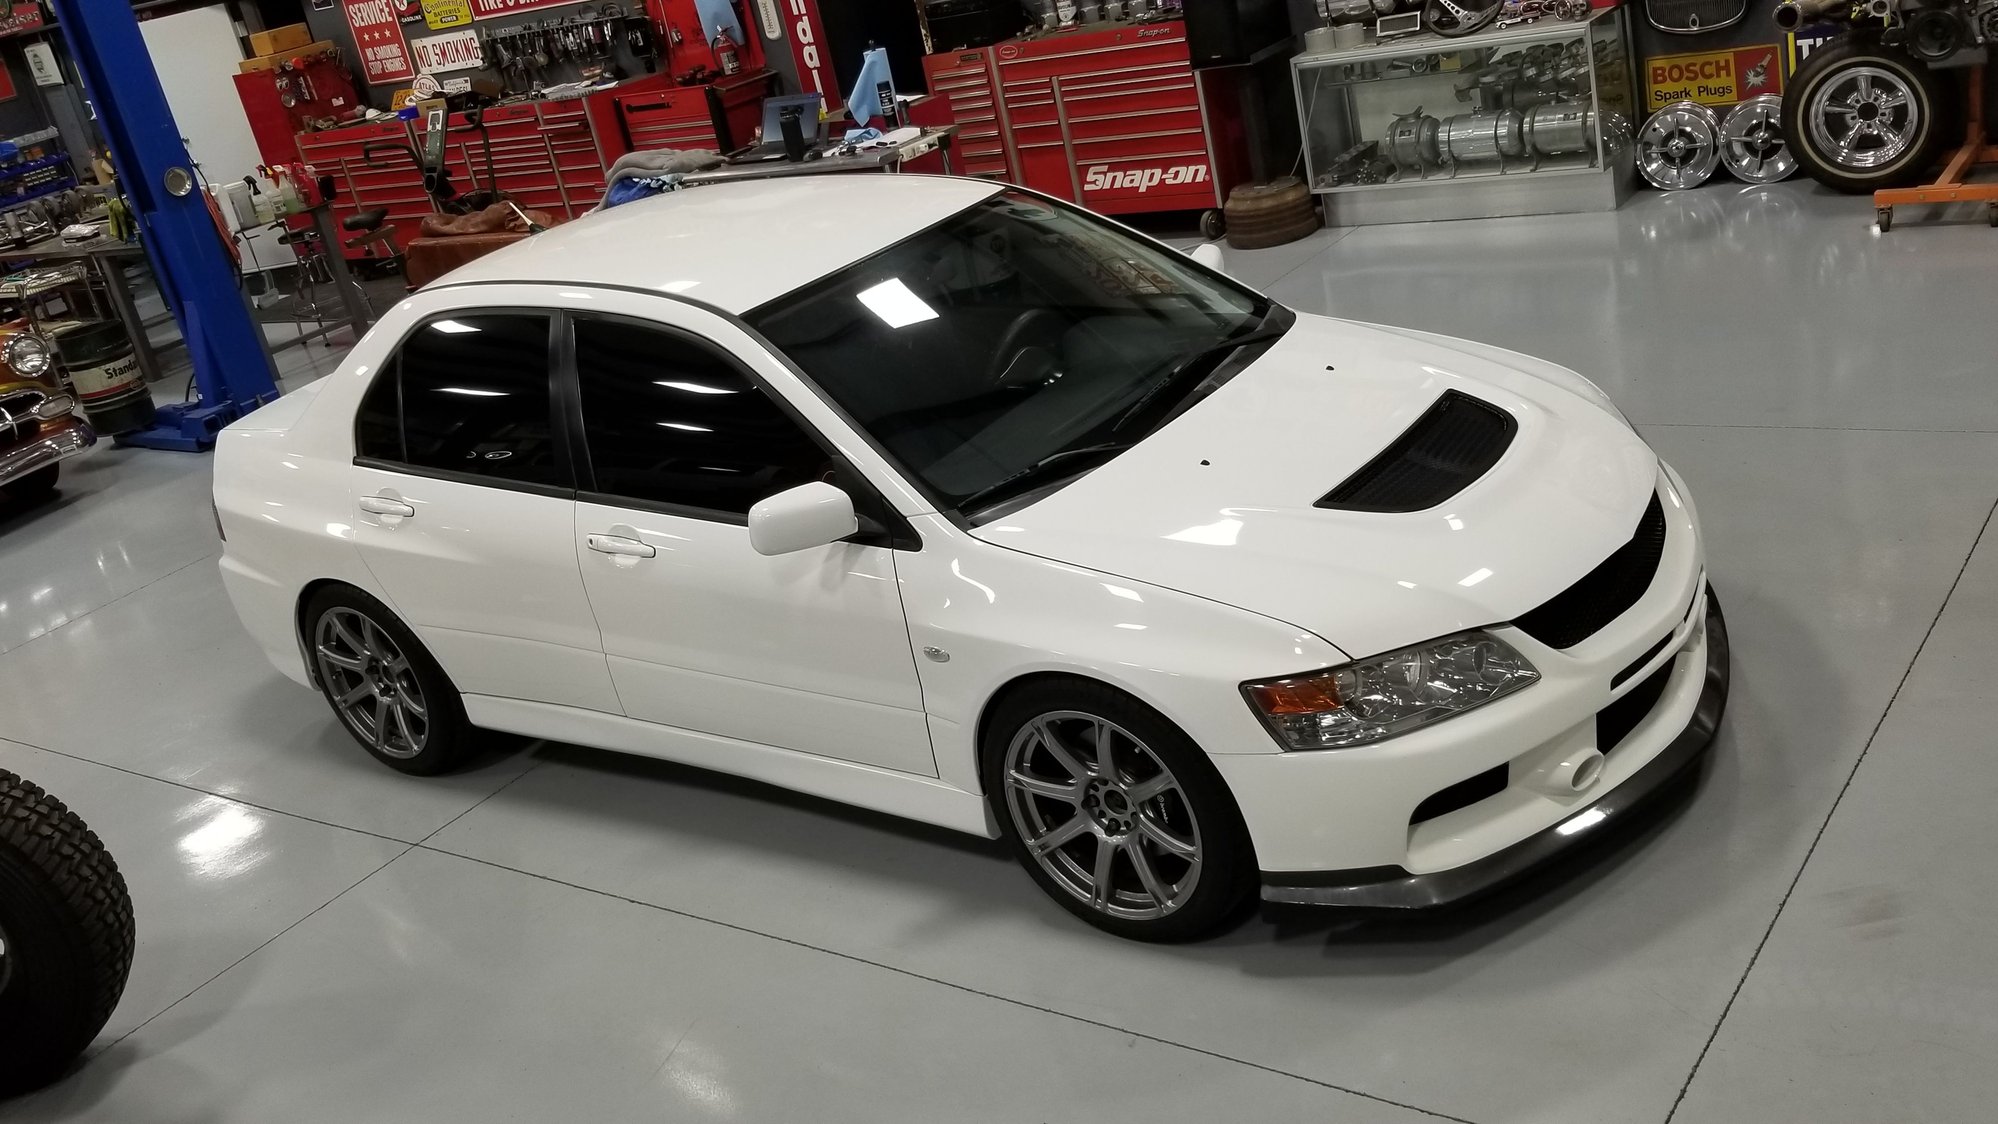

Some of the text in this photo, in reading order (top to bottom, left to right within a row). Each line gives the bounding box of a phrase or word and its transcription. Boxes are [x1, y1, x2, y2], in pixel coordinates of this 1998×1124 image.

[348, 0, 393, 28] SERVICE
[433, 7, 461, 18] BATTERIES
[364, 43, 402, 62] NO SMOKING
[415, 37, 480, 69] NO SMOKING
[368, 57, 407, 76] STOP ENGINES
[1652, 59, 1731, 84] BOSCH
[1654, 84, 1733, 102] Spark Plugs
[1083, 164, 1206, 192] Snap-on
